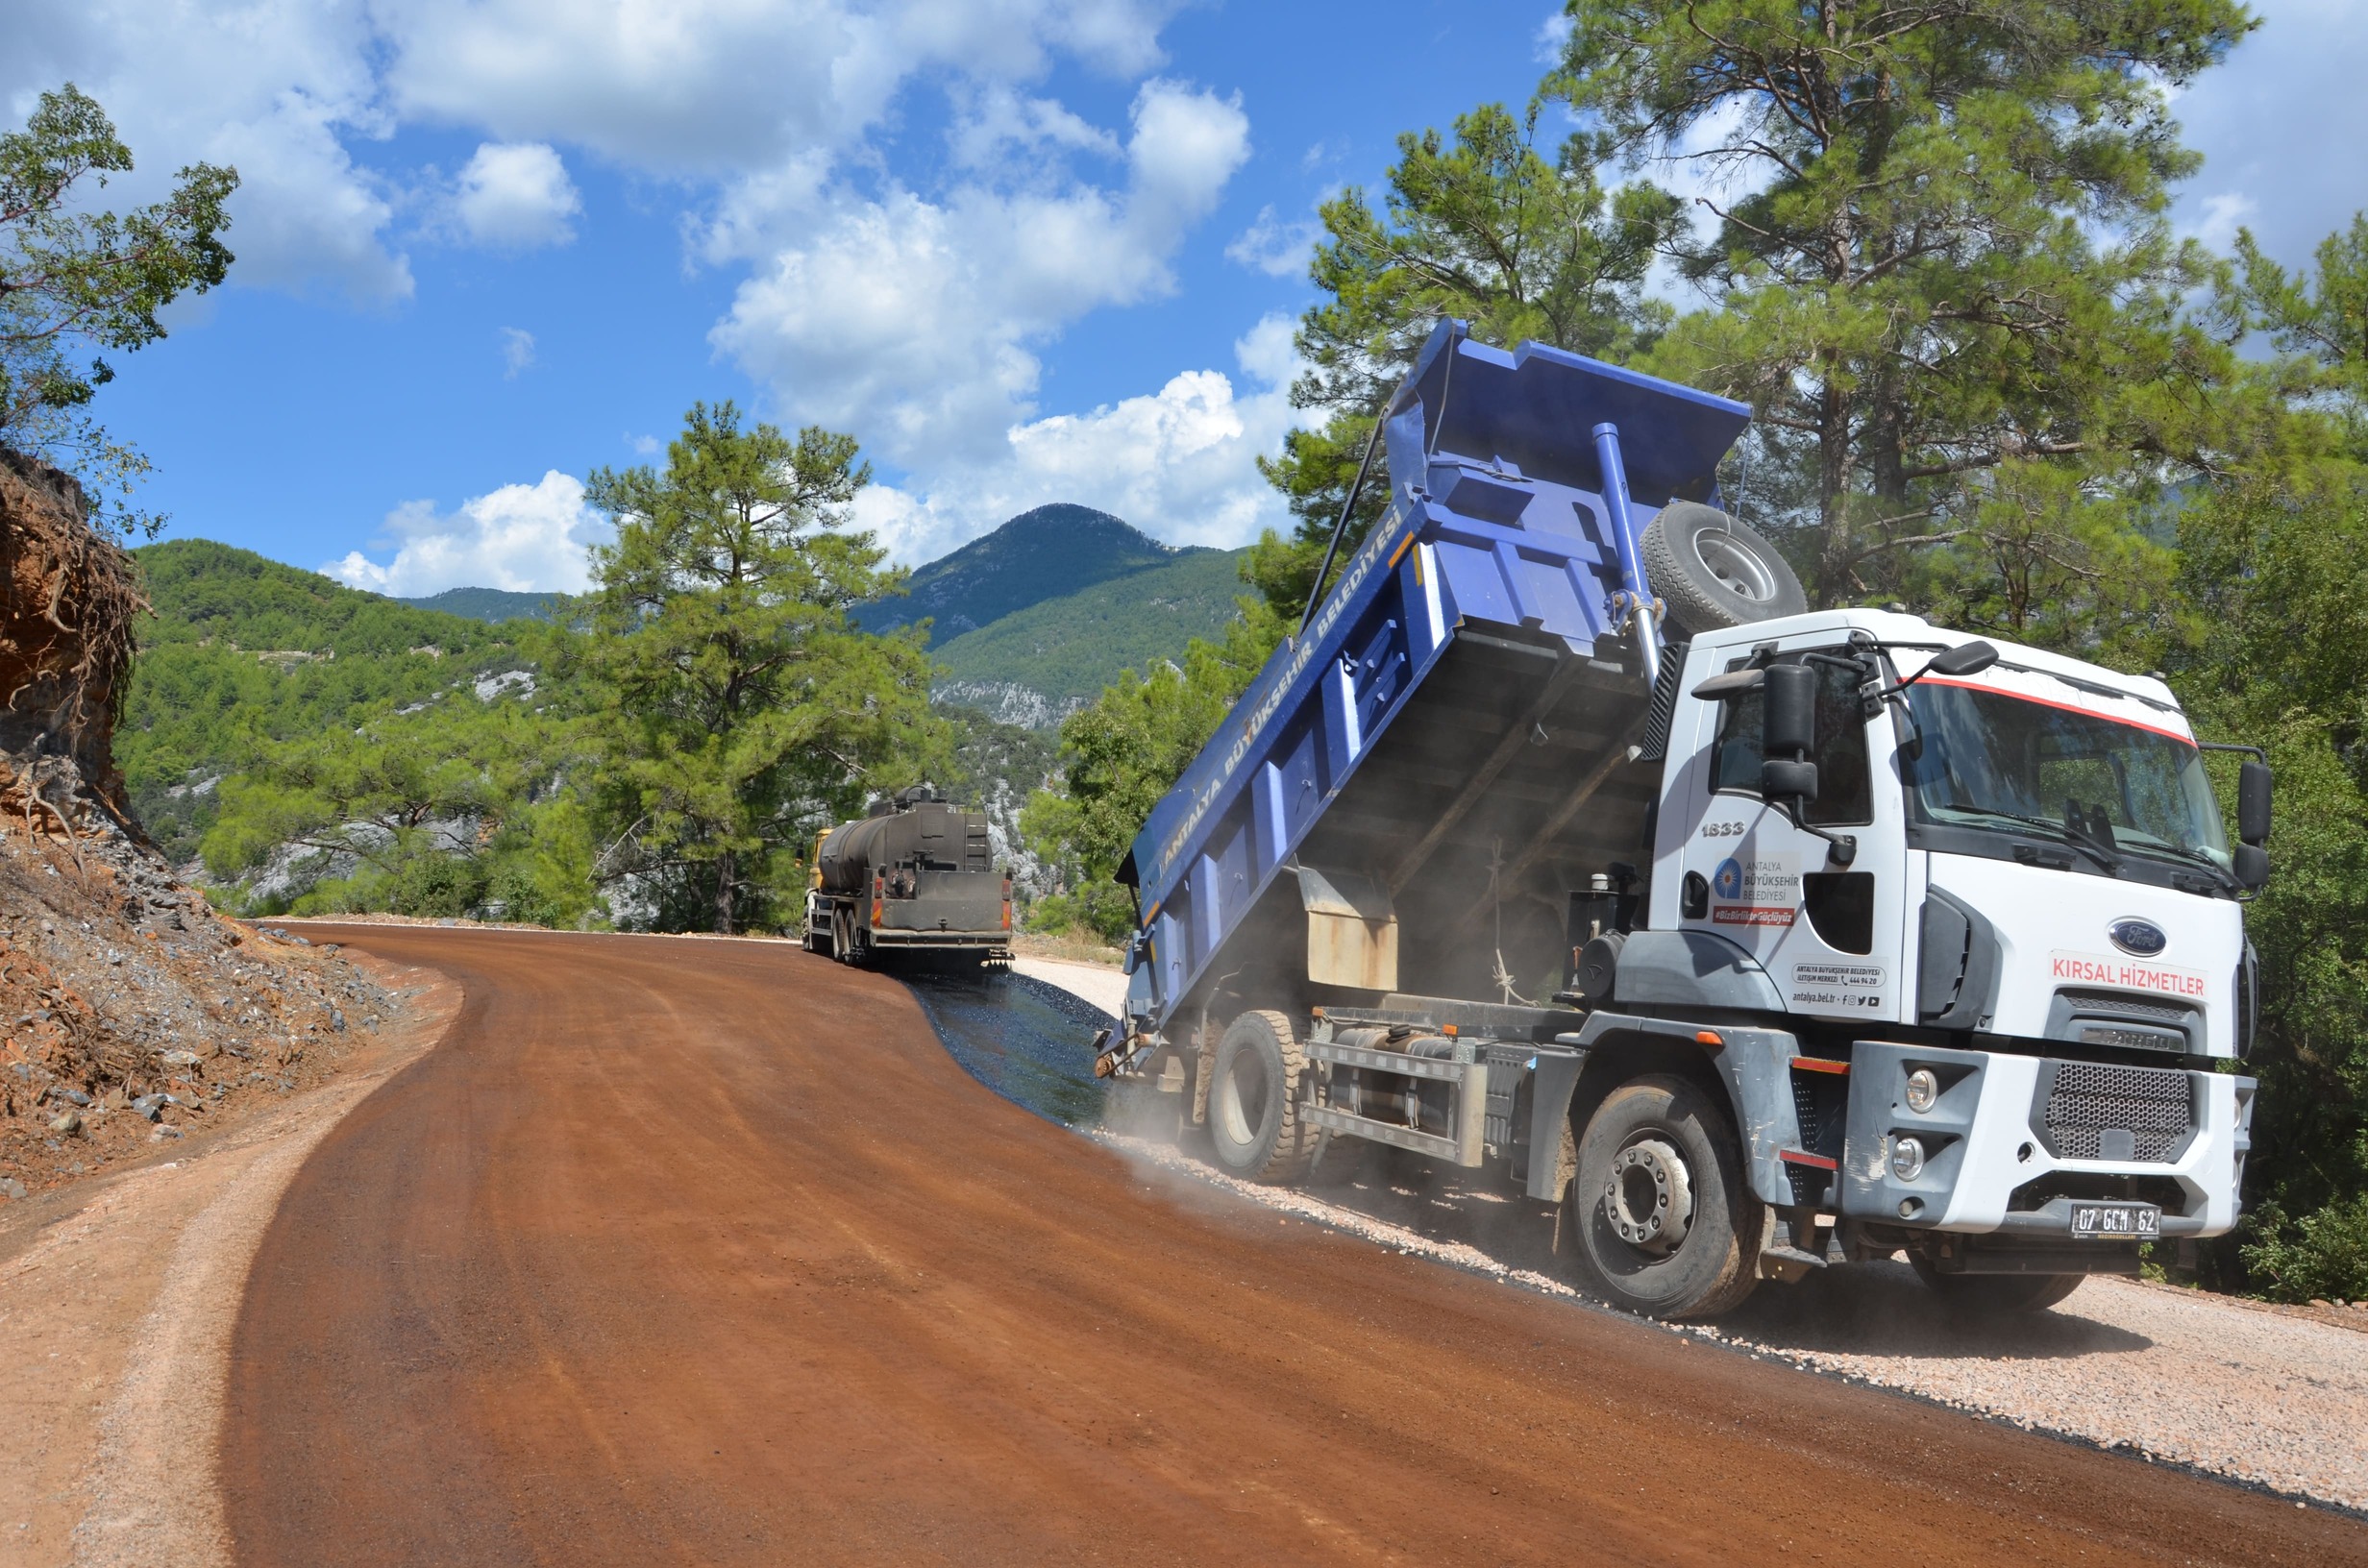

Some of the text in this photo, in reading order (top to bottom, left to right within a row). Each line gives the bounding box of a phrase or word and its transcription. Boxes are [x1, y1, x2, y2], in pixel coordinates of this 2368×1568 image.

[1165, 778, 1221, 868] ANTALYA
[1317, 504, 1403, 639] BELEDİYESİ
[1702, 821, 1745, 837] 1833
[1745, 862, 1782, 871] ANTALYA
[1744, 873, 1799, 888] BÜYÜKŞEHİR
[1743, 889, 1787, 901] BELEDİYESİ
[1715, 910, 1792, 924] #BizBirlikteGüçlüyüz
[2127, 925, 2158, 947] Ford
[1850, 968, 1881, 976] BELEDİYESİ
[2053, 958, 2204, 996] KIRSAL HİZMETLER
[1792, 992, 1836, 1004] antalya.bel.tr
[2079, 1209, 2096, 1231] 07
[2138, 1211, 2155, 1232] 62
